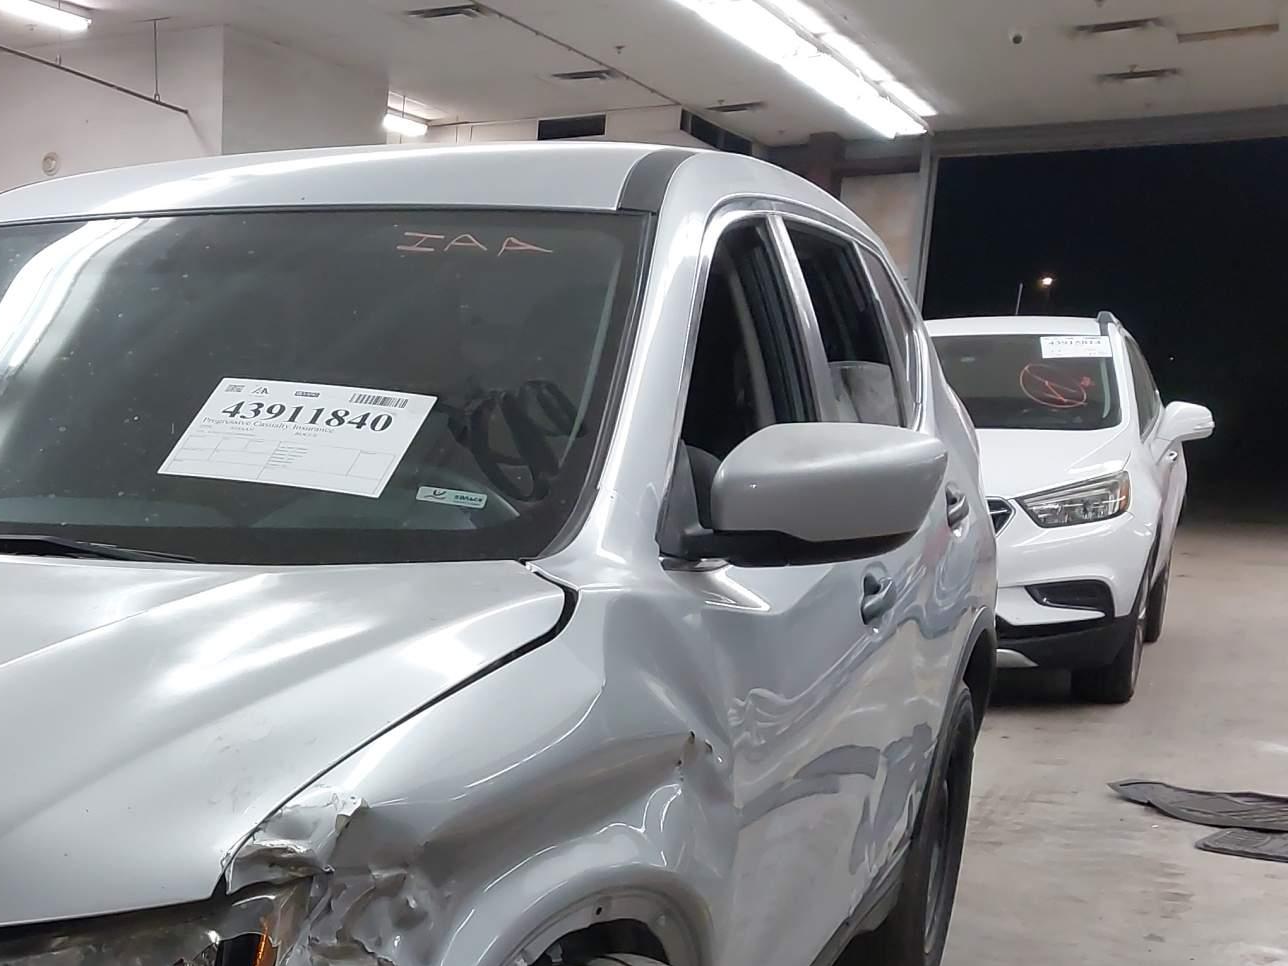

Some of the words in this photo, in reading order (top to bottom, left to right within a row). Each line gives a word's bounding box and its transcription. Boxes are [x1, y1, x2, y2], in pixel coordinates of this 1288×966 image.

[396, 231, 553, 257] IAA
[221, 400, 393, 432] 43911840
[253, 420, 290, 431] Casualty
